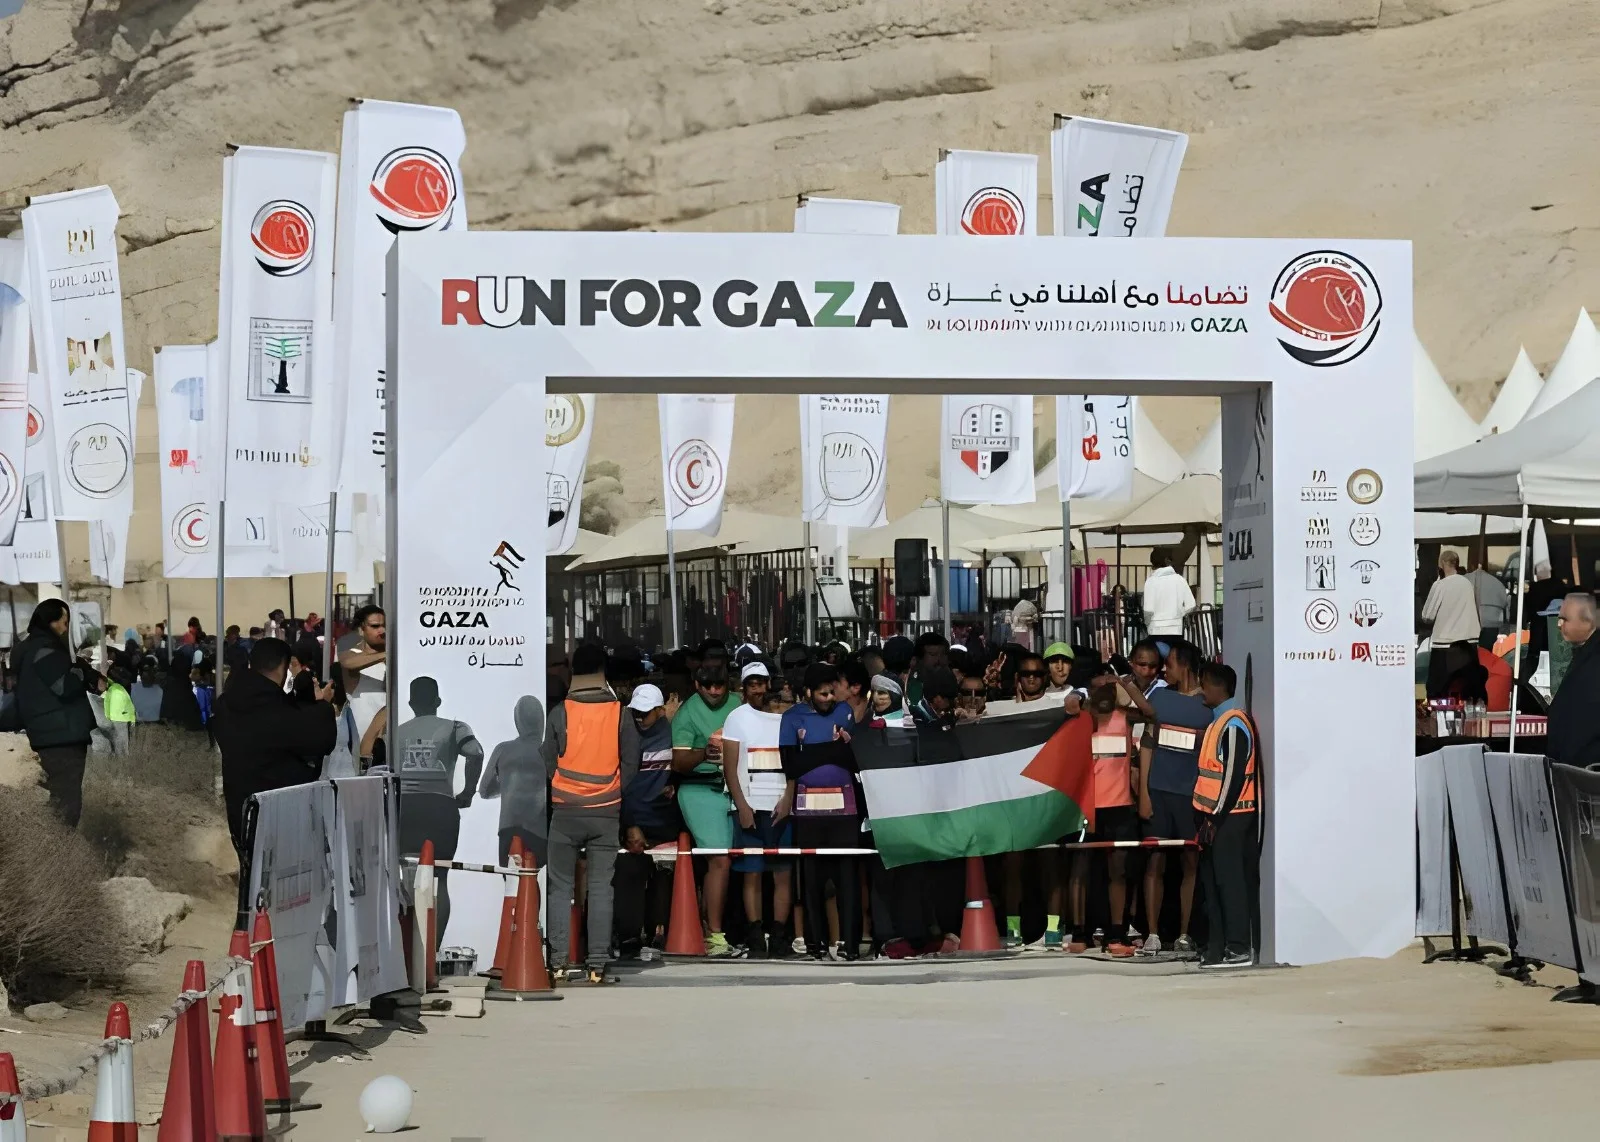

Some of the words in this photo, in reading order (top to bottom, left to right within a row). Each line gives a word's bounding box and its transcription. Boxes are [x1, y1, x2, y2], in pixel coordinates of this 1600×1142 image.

[1077, 172, 1110, 236] ZA
[441, 276, 566, 328] RUN
[580, 278, 701, 327] FOR
[712, 279, 908, 328] GAZA
[1009, 284, 1049, 313] في
[1123, 285, 1159, 308] مع
[419, 611, 489, 628] GAZA
